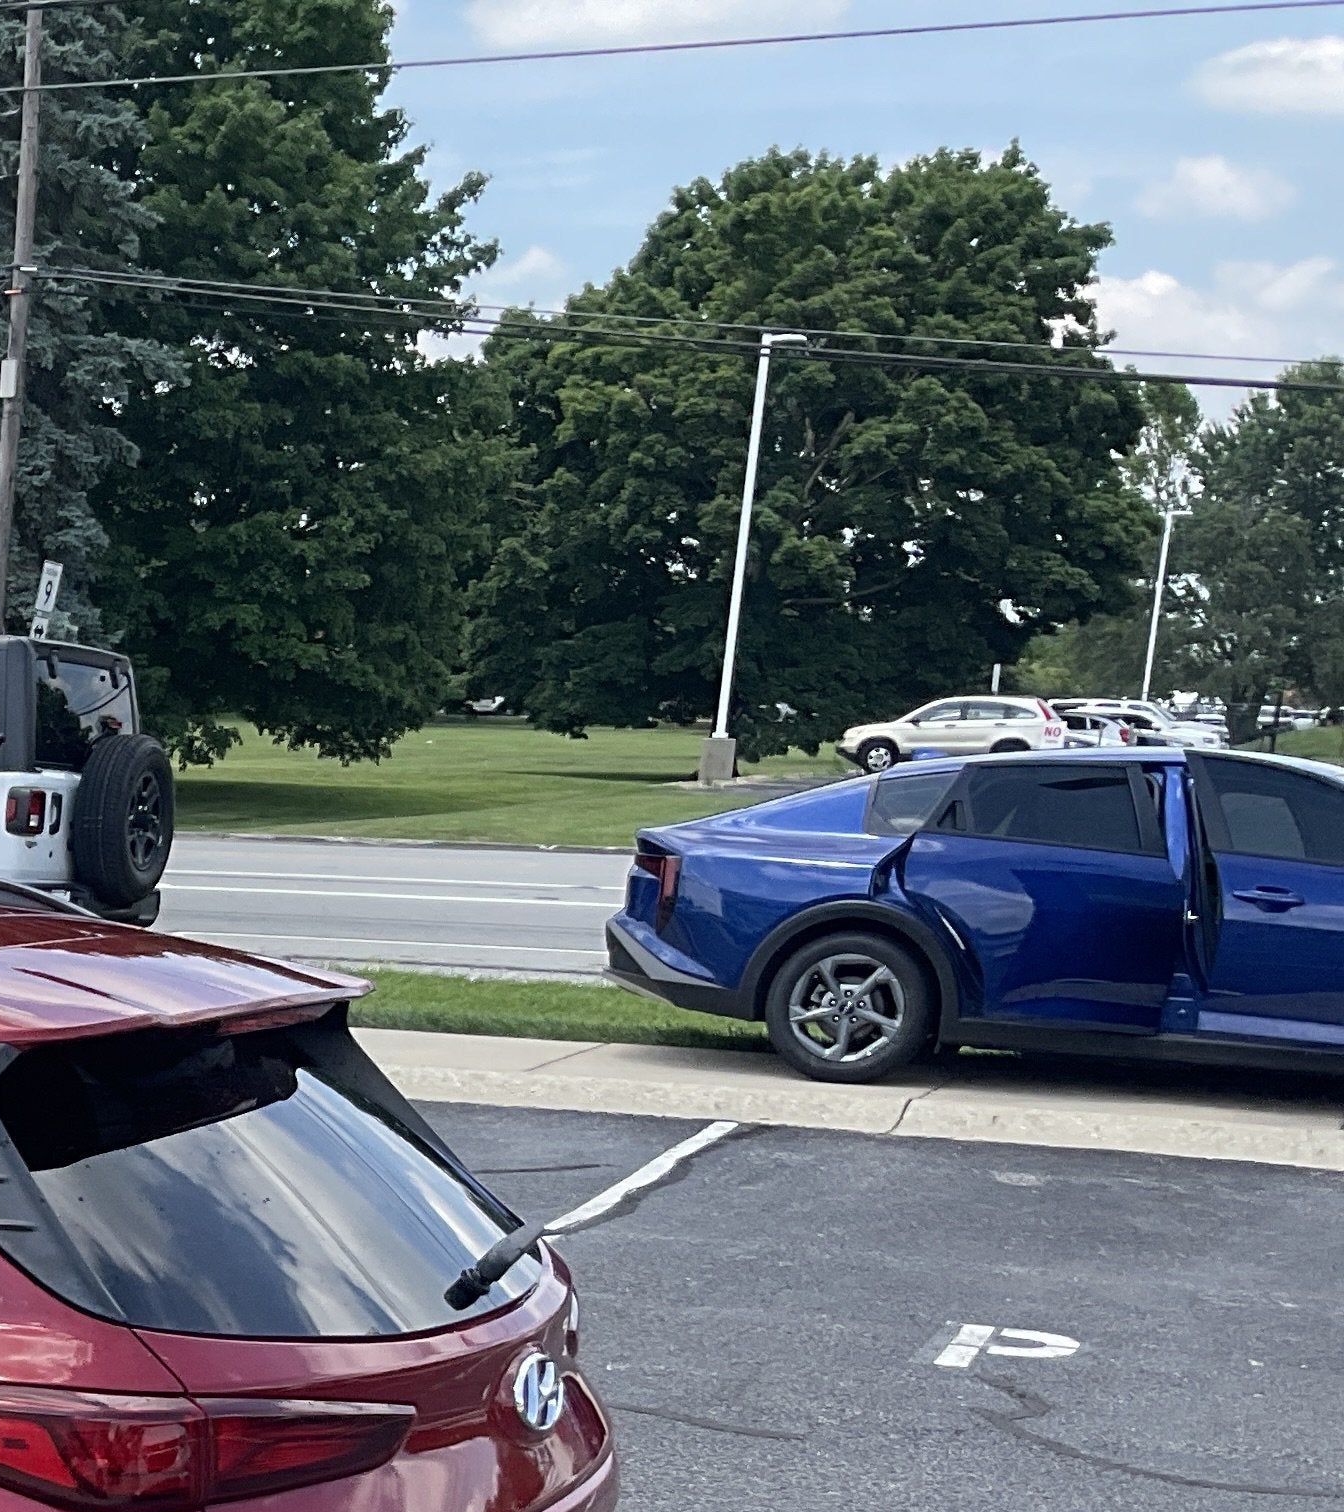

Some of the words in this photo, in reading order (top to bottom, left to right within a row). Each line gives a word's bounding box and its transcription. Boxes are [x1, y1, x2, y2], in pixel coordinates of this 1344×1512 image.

[43, 581, 52, 606] 9
[1044, 726, 1062, 738] NO
[933, 1323, 1081, 1368] P
